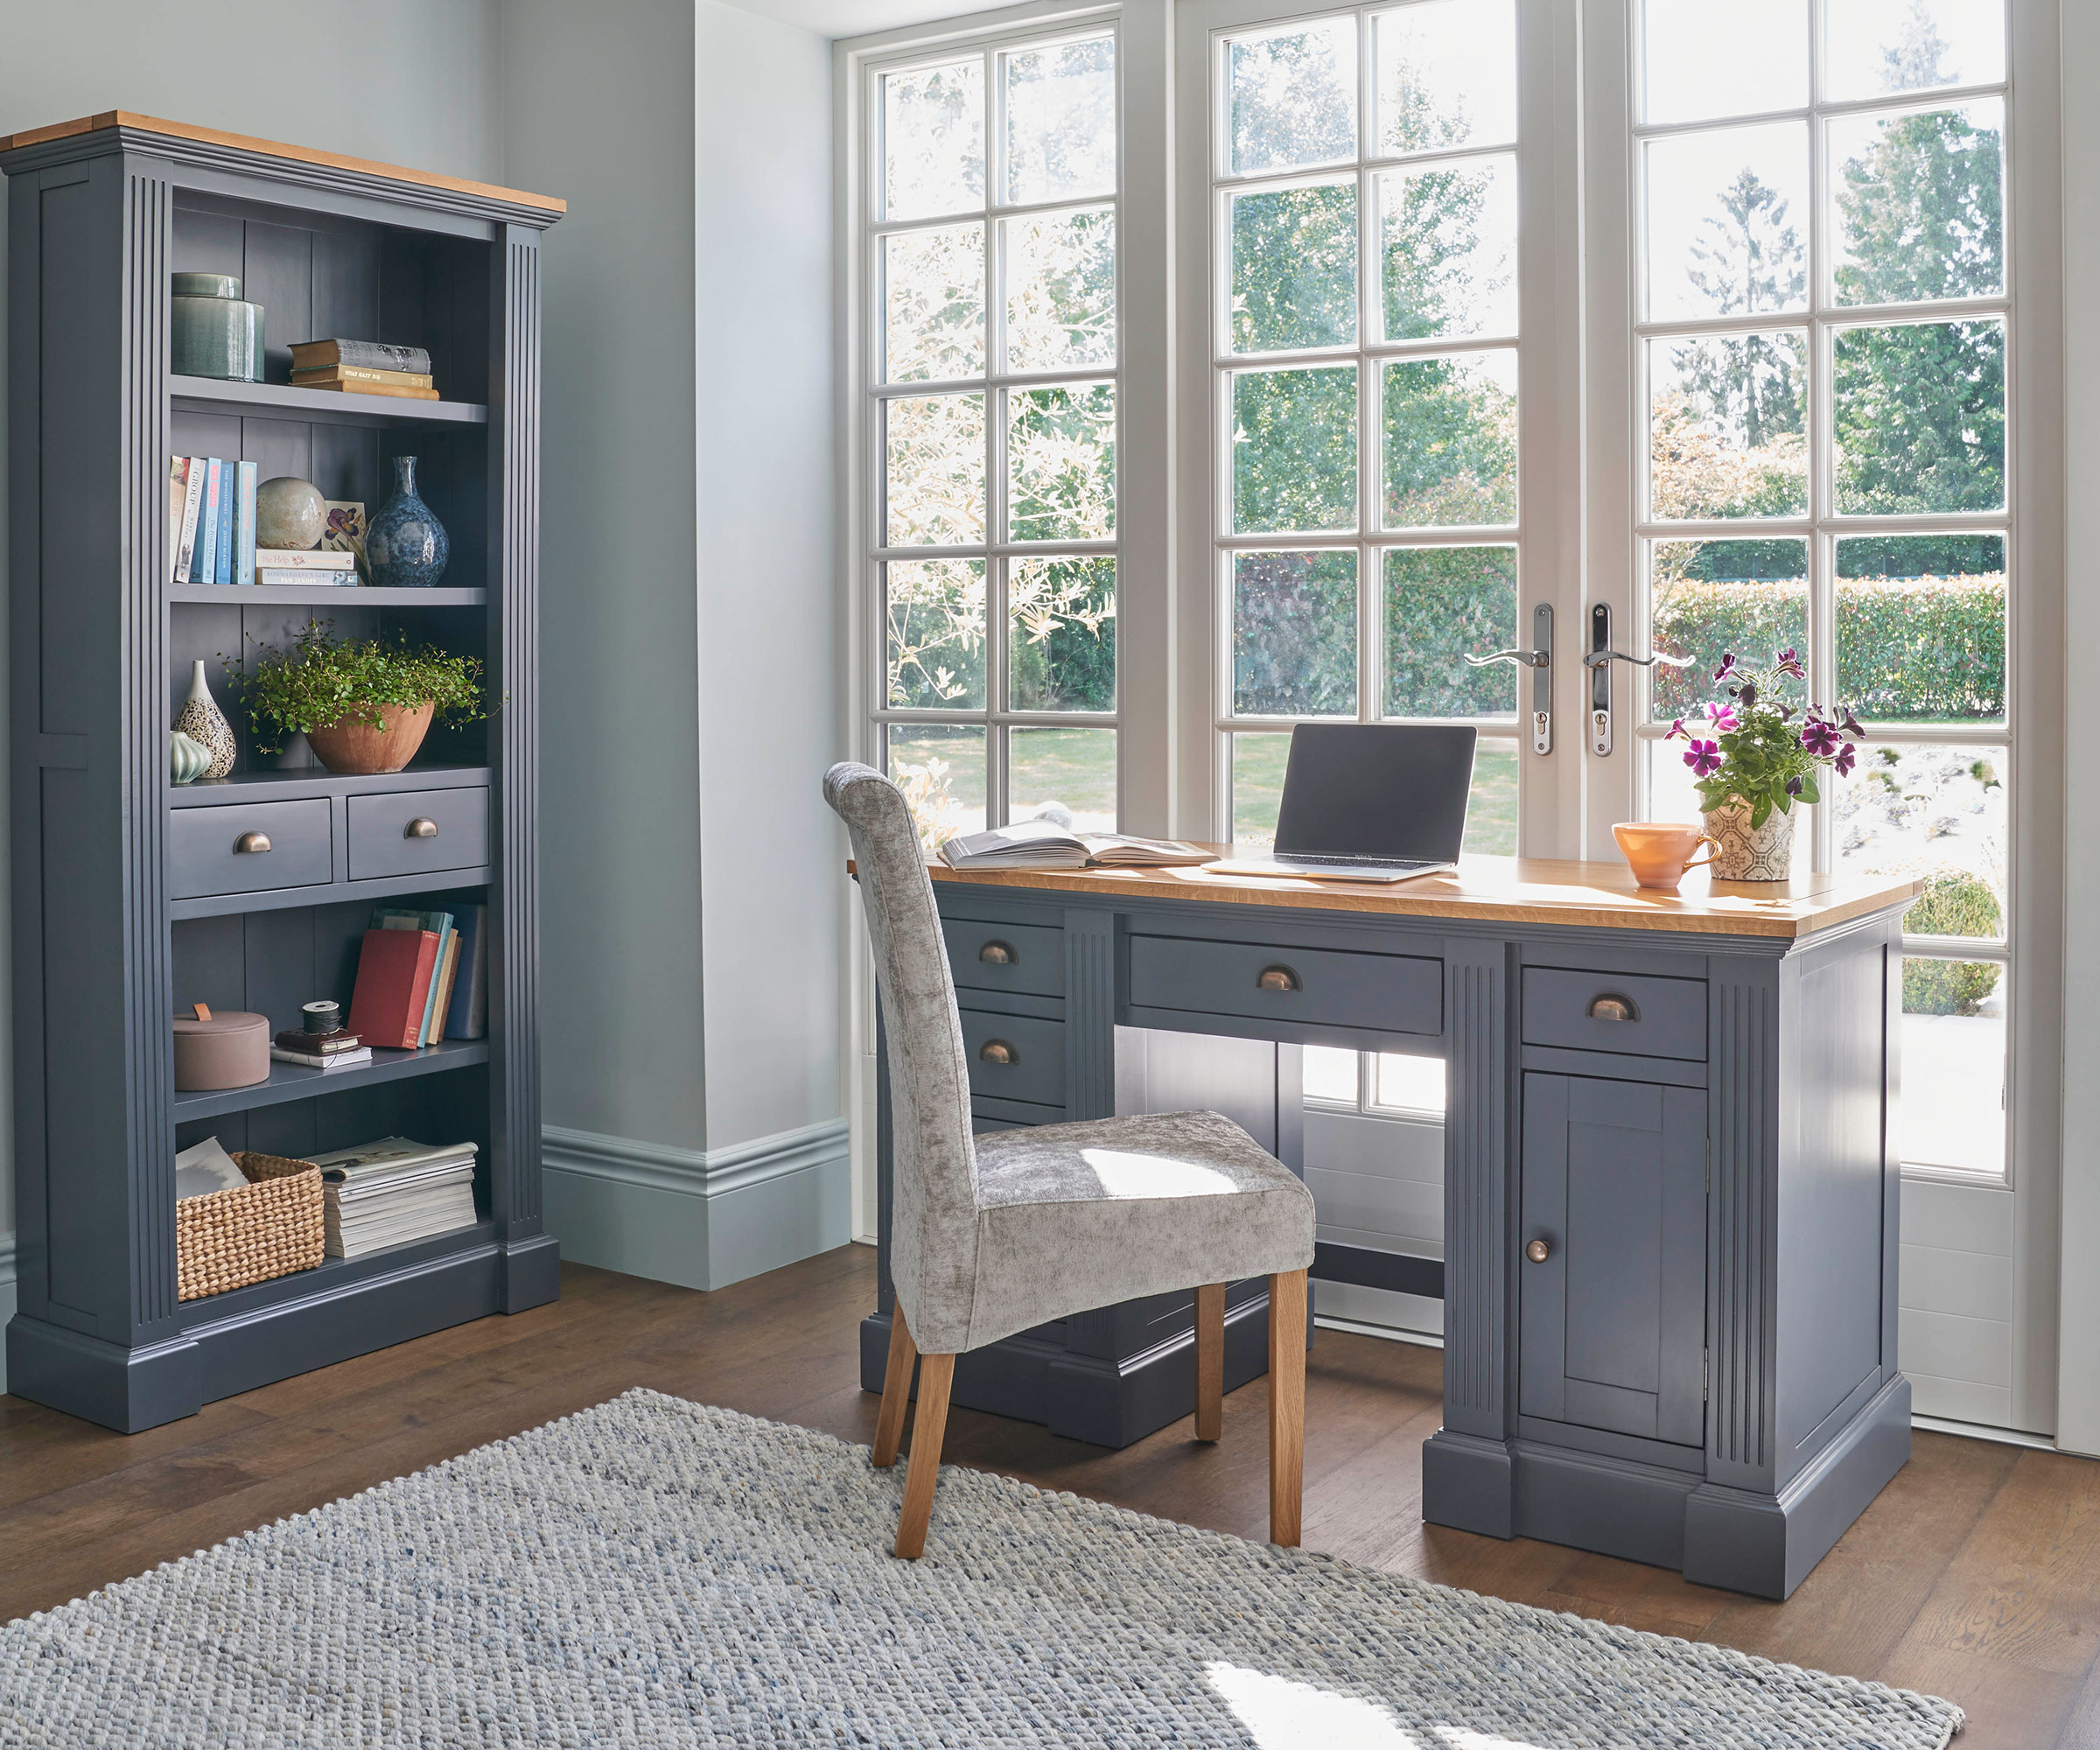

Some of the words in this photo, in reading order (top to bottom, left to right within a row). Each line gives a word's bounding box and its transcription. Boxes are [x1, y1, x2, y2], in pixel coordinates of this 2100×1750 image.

[210, 465, 219, 480] NORA
[189, 471, 200, 506] GROUP
[209, 481, 219, 508] ROBERTS
[274, 555, 289, 565] Help
